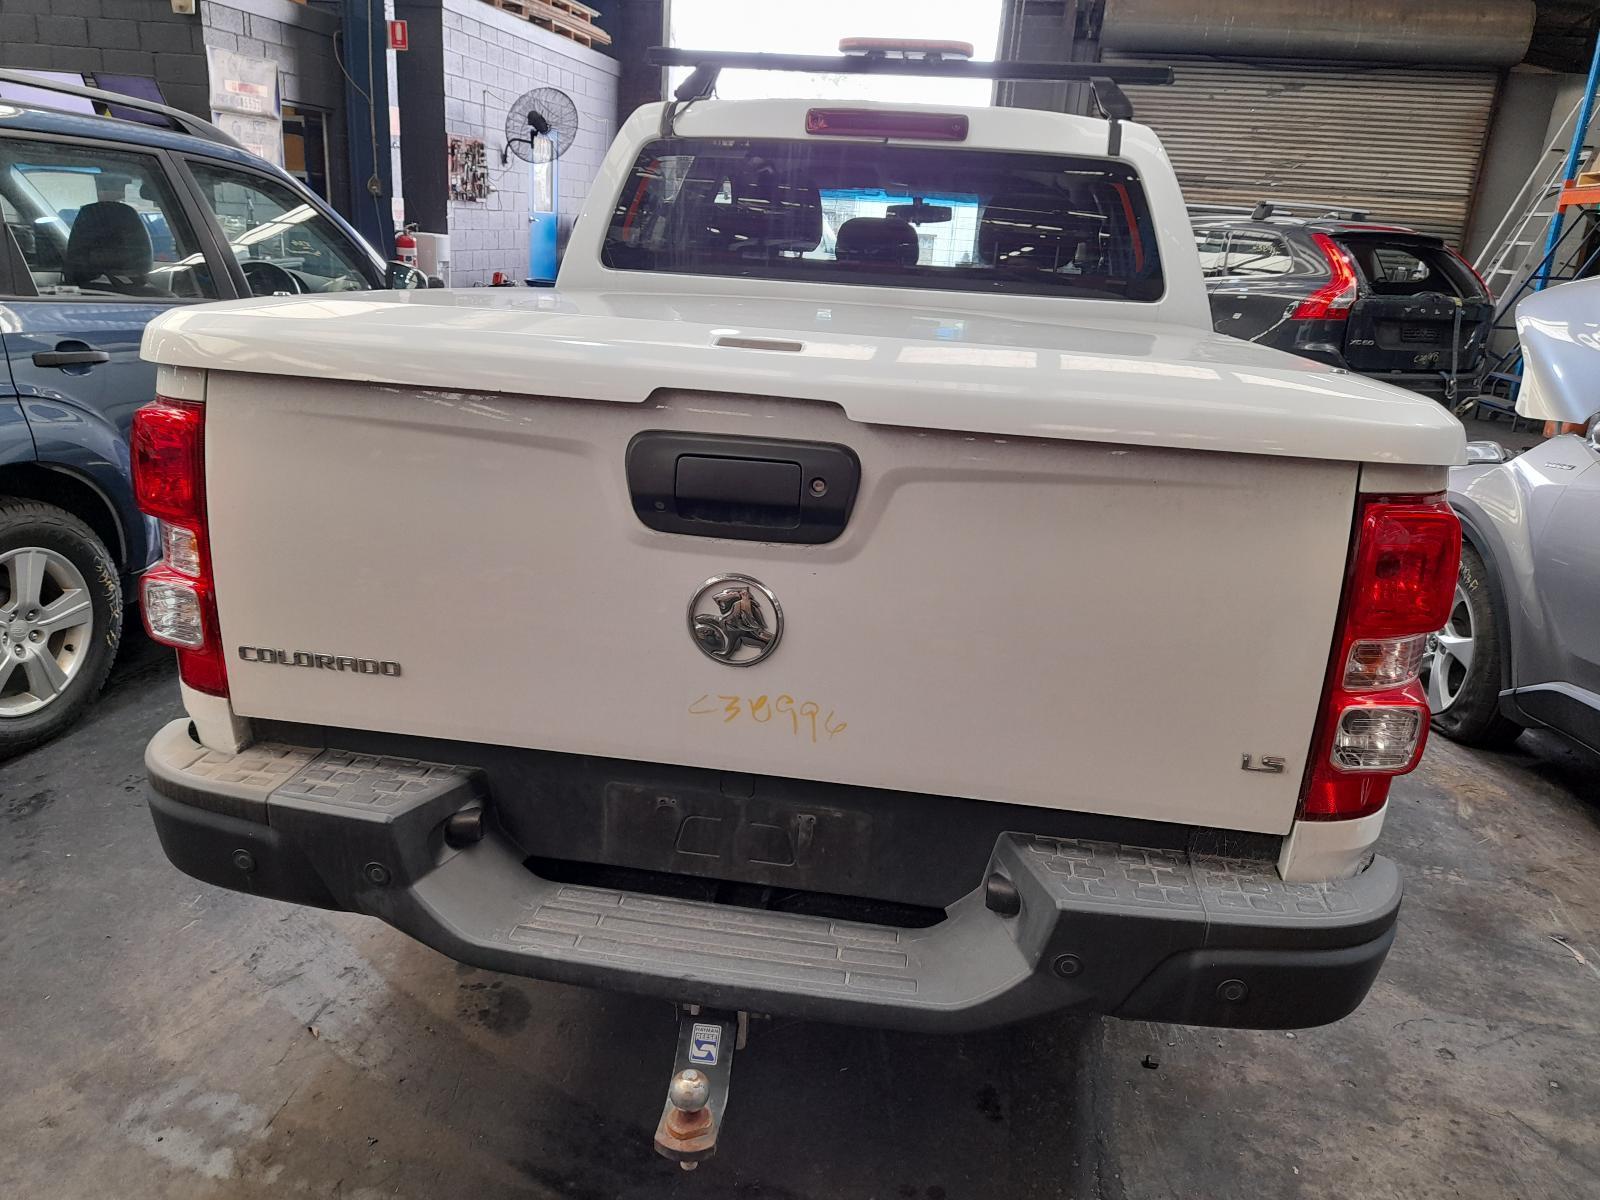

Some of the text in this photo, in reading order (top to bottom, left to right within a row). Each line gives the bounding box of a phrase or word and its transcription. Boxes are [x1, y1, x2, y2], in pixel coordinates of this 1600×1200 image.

[1403, 307, 1467, 316] VOLVO
[238, 645, 402, 677] COLORADO
[1241, 752, 1287, 774] LS
